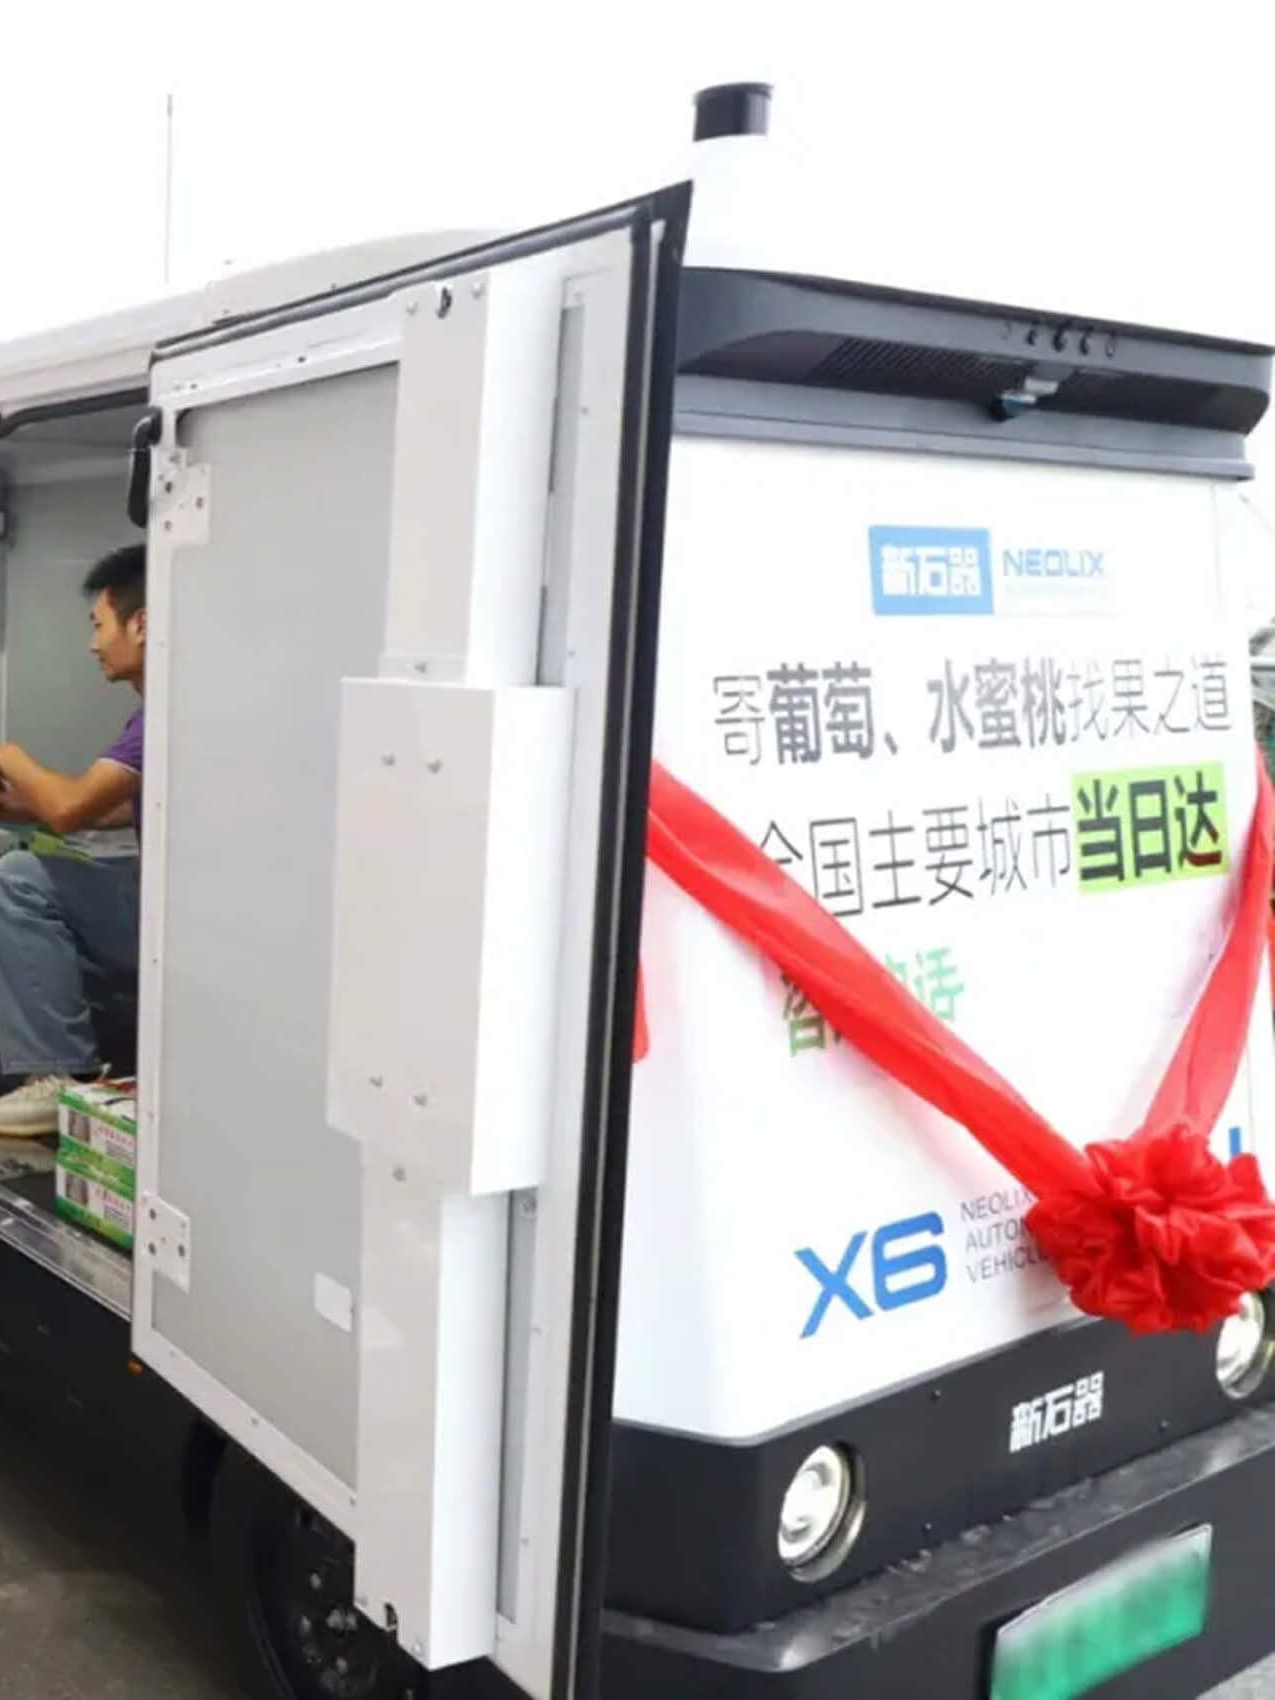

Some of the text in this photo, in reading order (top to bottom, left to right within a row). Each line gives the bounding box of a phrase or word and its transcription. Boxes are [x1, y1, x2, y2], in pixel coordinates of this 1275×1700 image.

[880, 545, 982, 597] 新石器
[1002, 548, 1106, 578] NEOLIX
[793, 1210, 948, 1340] X6
[1009, 1369, 1105, 1454] 新石器
